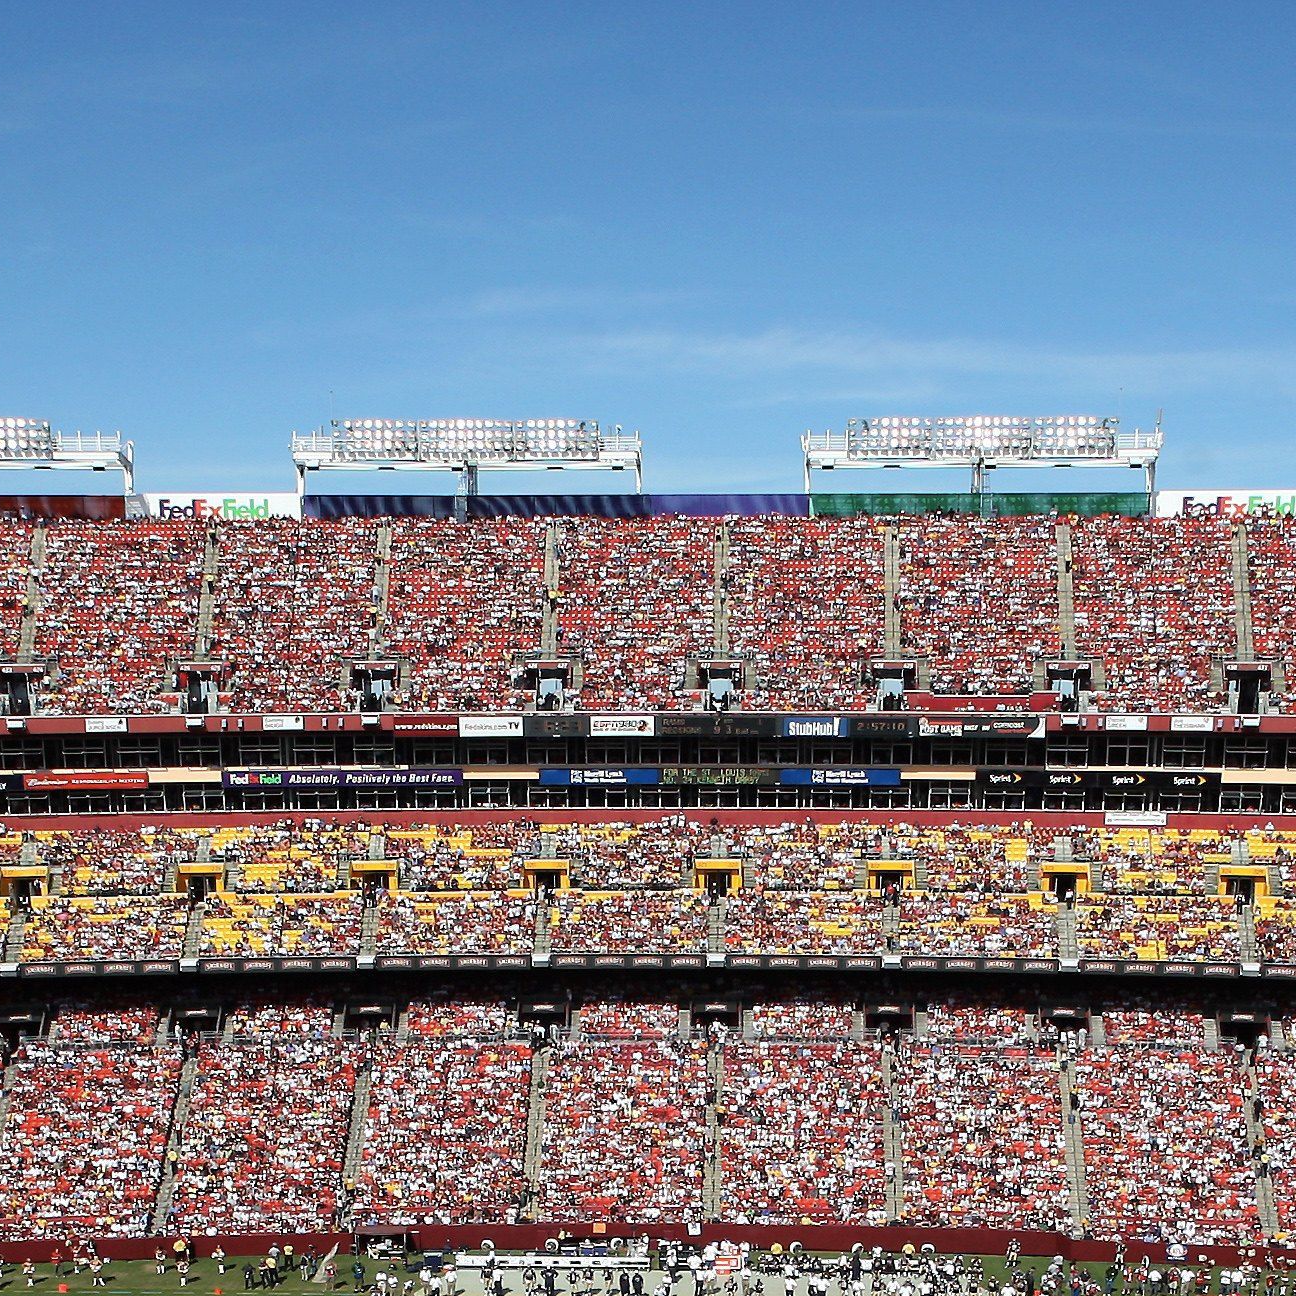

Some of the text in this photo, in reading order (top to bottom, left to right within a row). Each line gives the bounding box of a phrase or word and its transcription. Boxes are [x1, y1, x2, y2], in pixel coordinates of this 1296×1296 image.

[159, 498, 268, 519] FedExField
[508, 721, 519, 729] TV
[789, 717, 840, 736] StubHub!
[721, 769, 746, 777] LOUIS
[229, 773, 282, 785] FedExField
[393, 773, 407, 784] the
[409, 773, 429, 784] Best
[989, 774, 1012, 784] Sprint
[1049, 775, 1072, 785] Sprint
[1112, 776, 1134, 786] Sprint
[1173, 776, 1196, 786] Sprint
